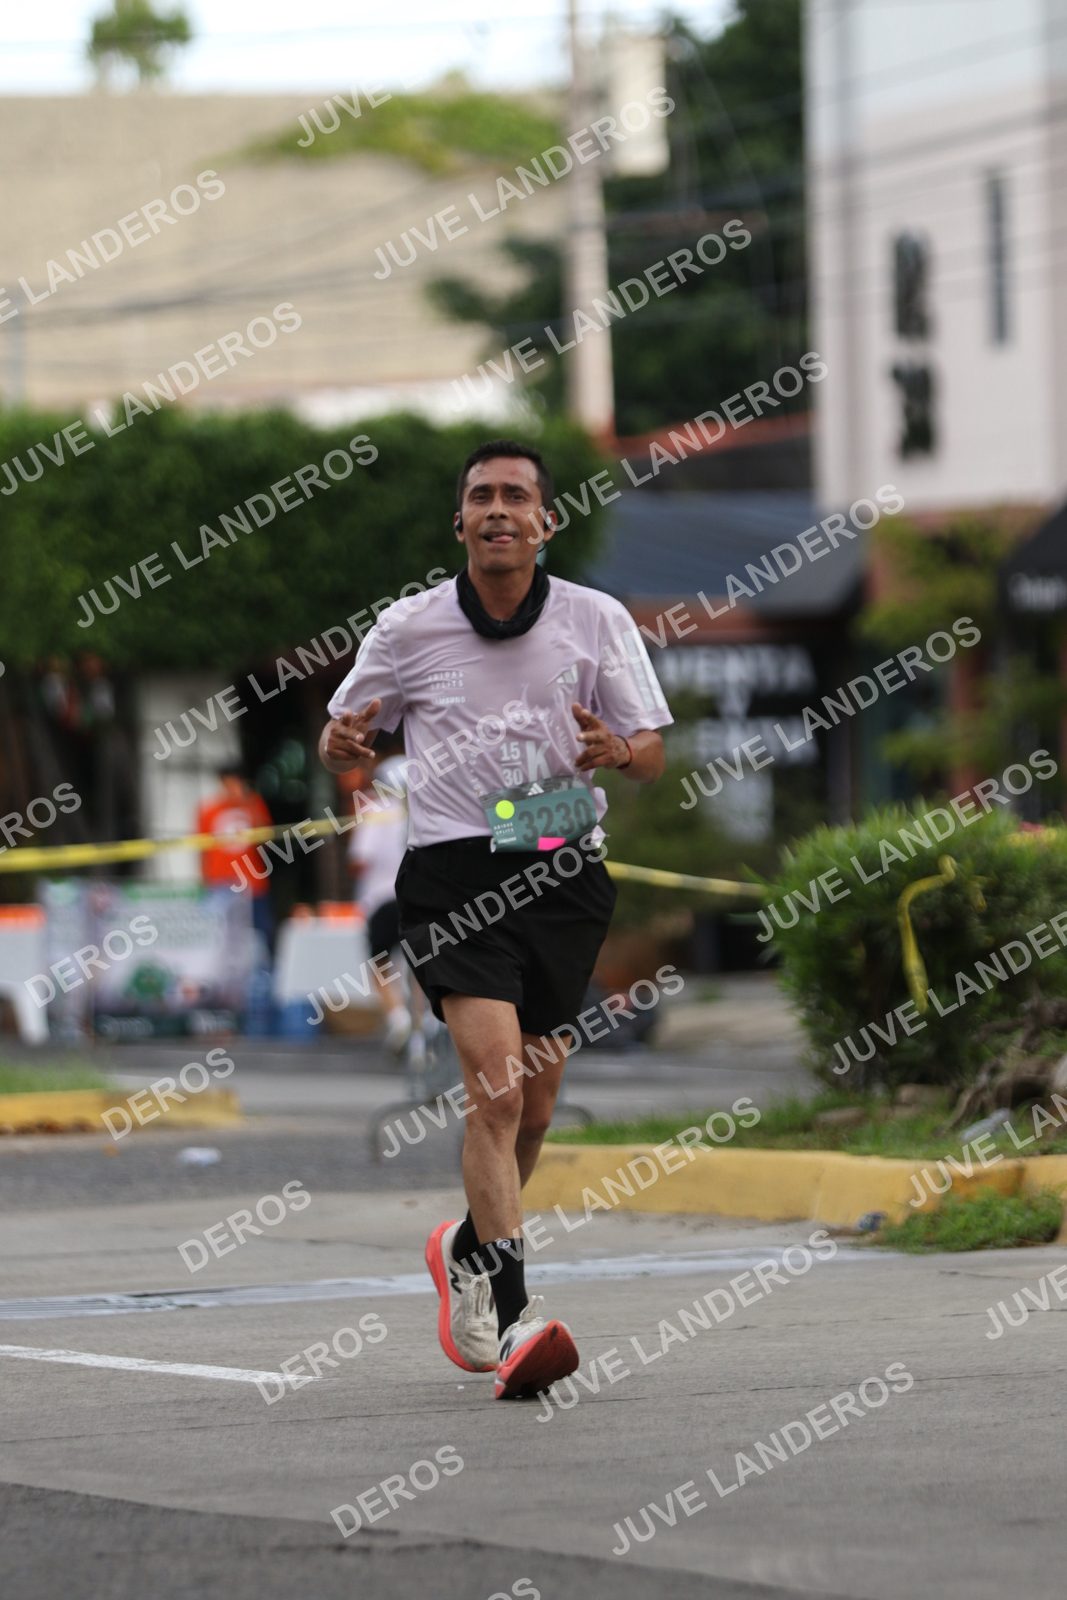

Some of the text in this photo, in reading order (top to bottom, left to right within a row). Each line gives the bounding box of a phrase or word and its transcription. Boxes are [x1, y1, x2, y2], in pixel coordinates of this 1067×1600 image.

[501, 741, 520, 761] 15
[524, 740, 551, 784] K
[503, 768, 523, 787] 30
[518, 797, 592, 844] 3230
